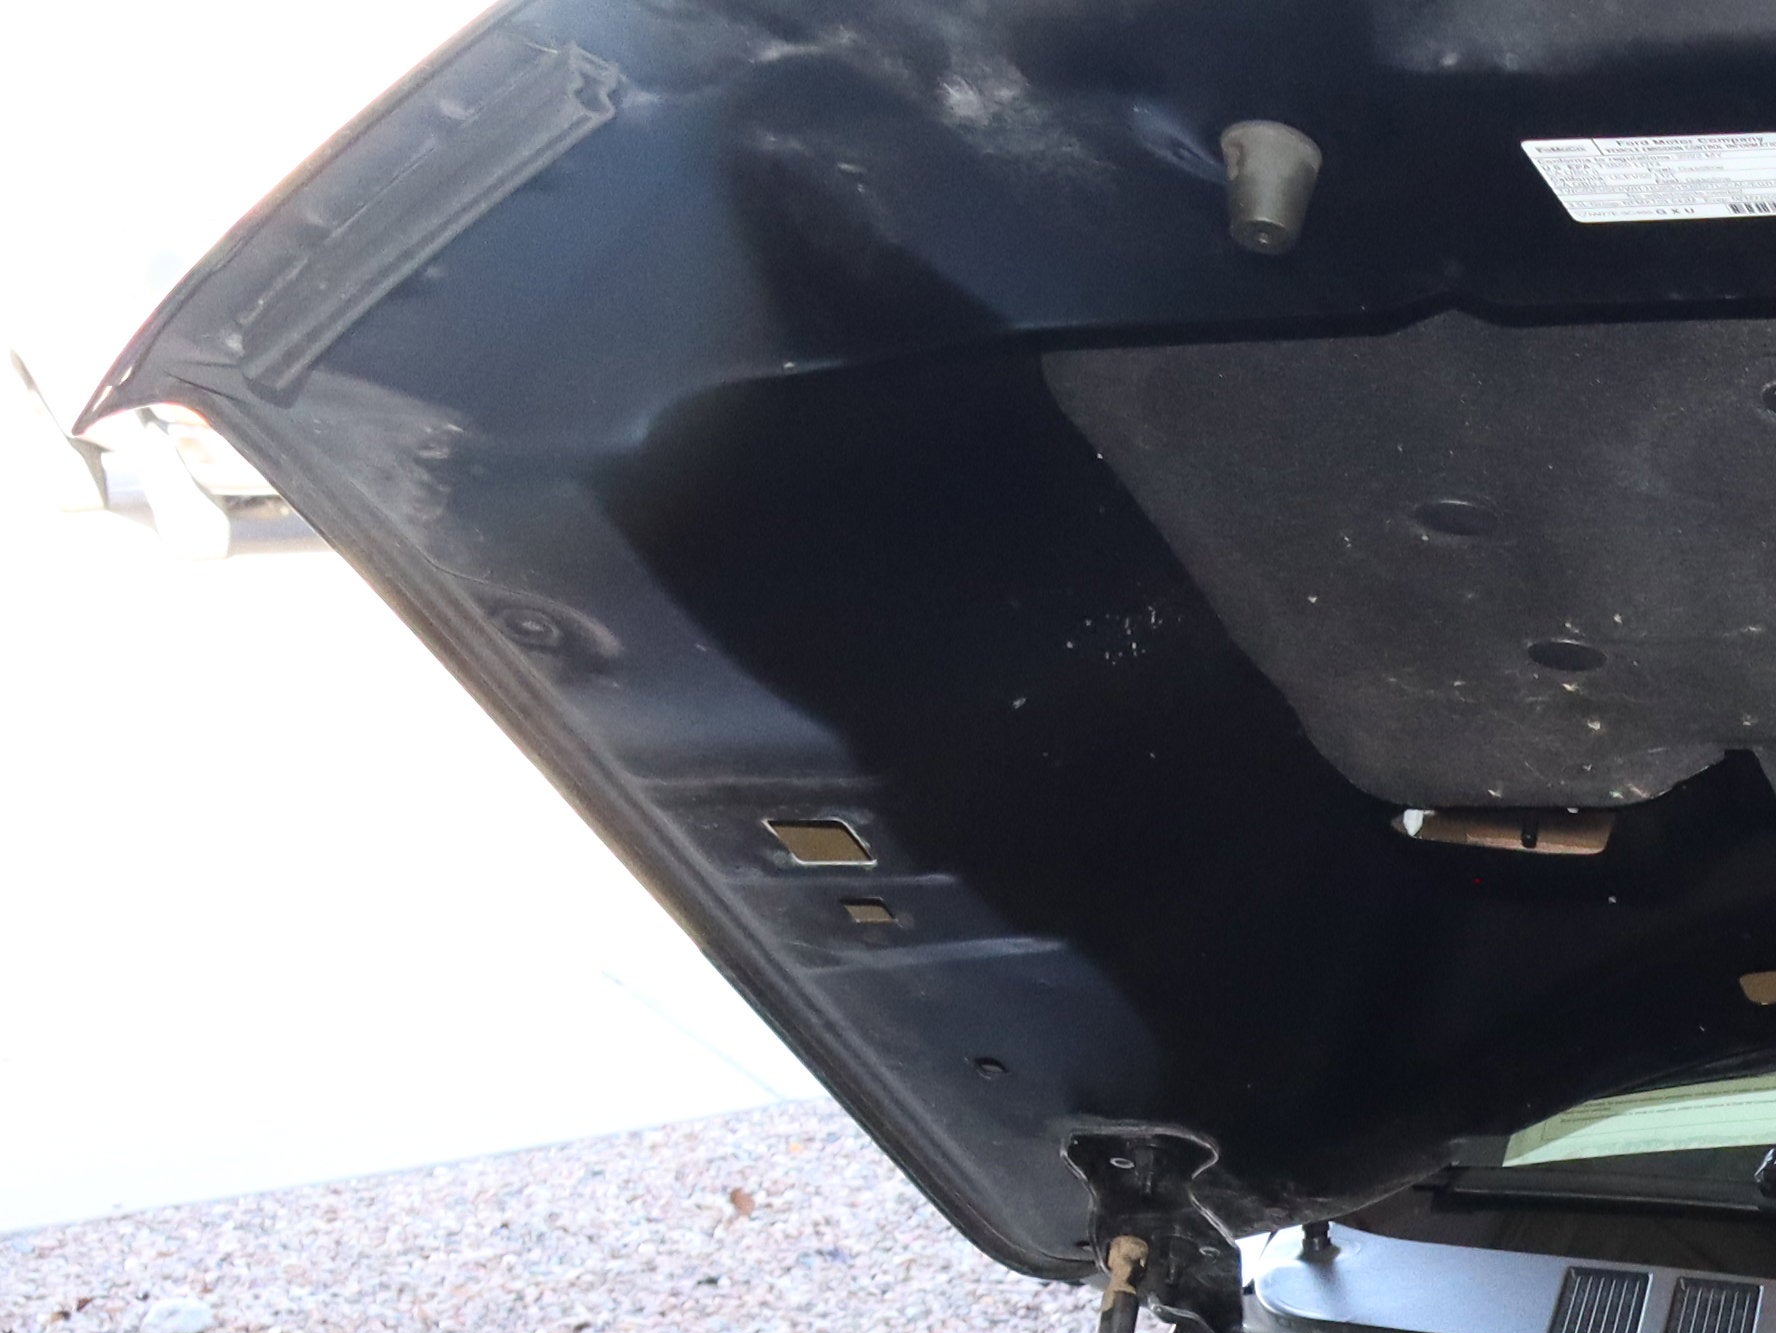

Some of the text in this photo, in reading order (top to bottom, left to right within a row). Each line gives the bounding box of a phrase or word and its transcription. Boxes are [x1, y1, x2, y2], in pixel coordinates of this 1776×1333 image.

[1615, 134, 1765, 147] Ford Motor Company
[1603, 146, 1641, 154] VEHICLE
